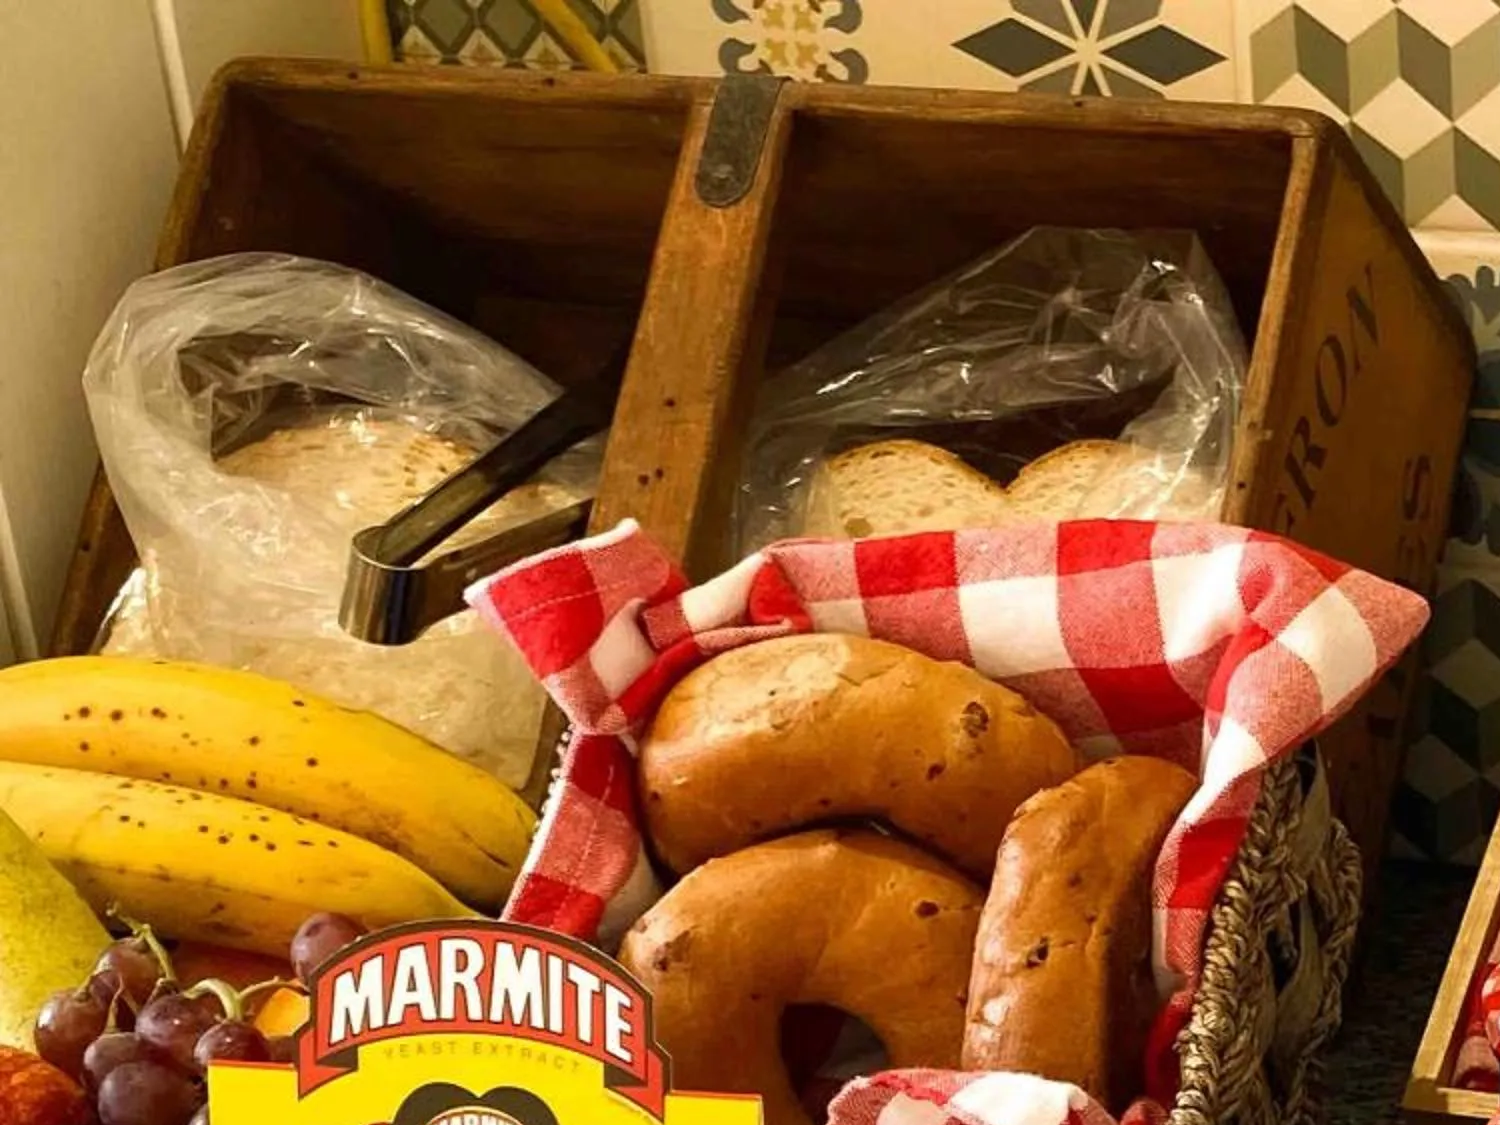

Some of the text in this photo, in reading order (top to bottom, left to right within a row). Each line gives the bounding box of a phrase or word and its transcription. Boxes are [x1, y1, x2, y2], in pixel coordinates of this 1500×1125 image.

[328, 937, 634, 1064] MARMITE
[384, 1040, 582, 1073] YEAST EXTRACT
